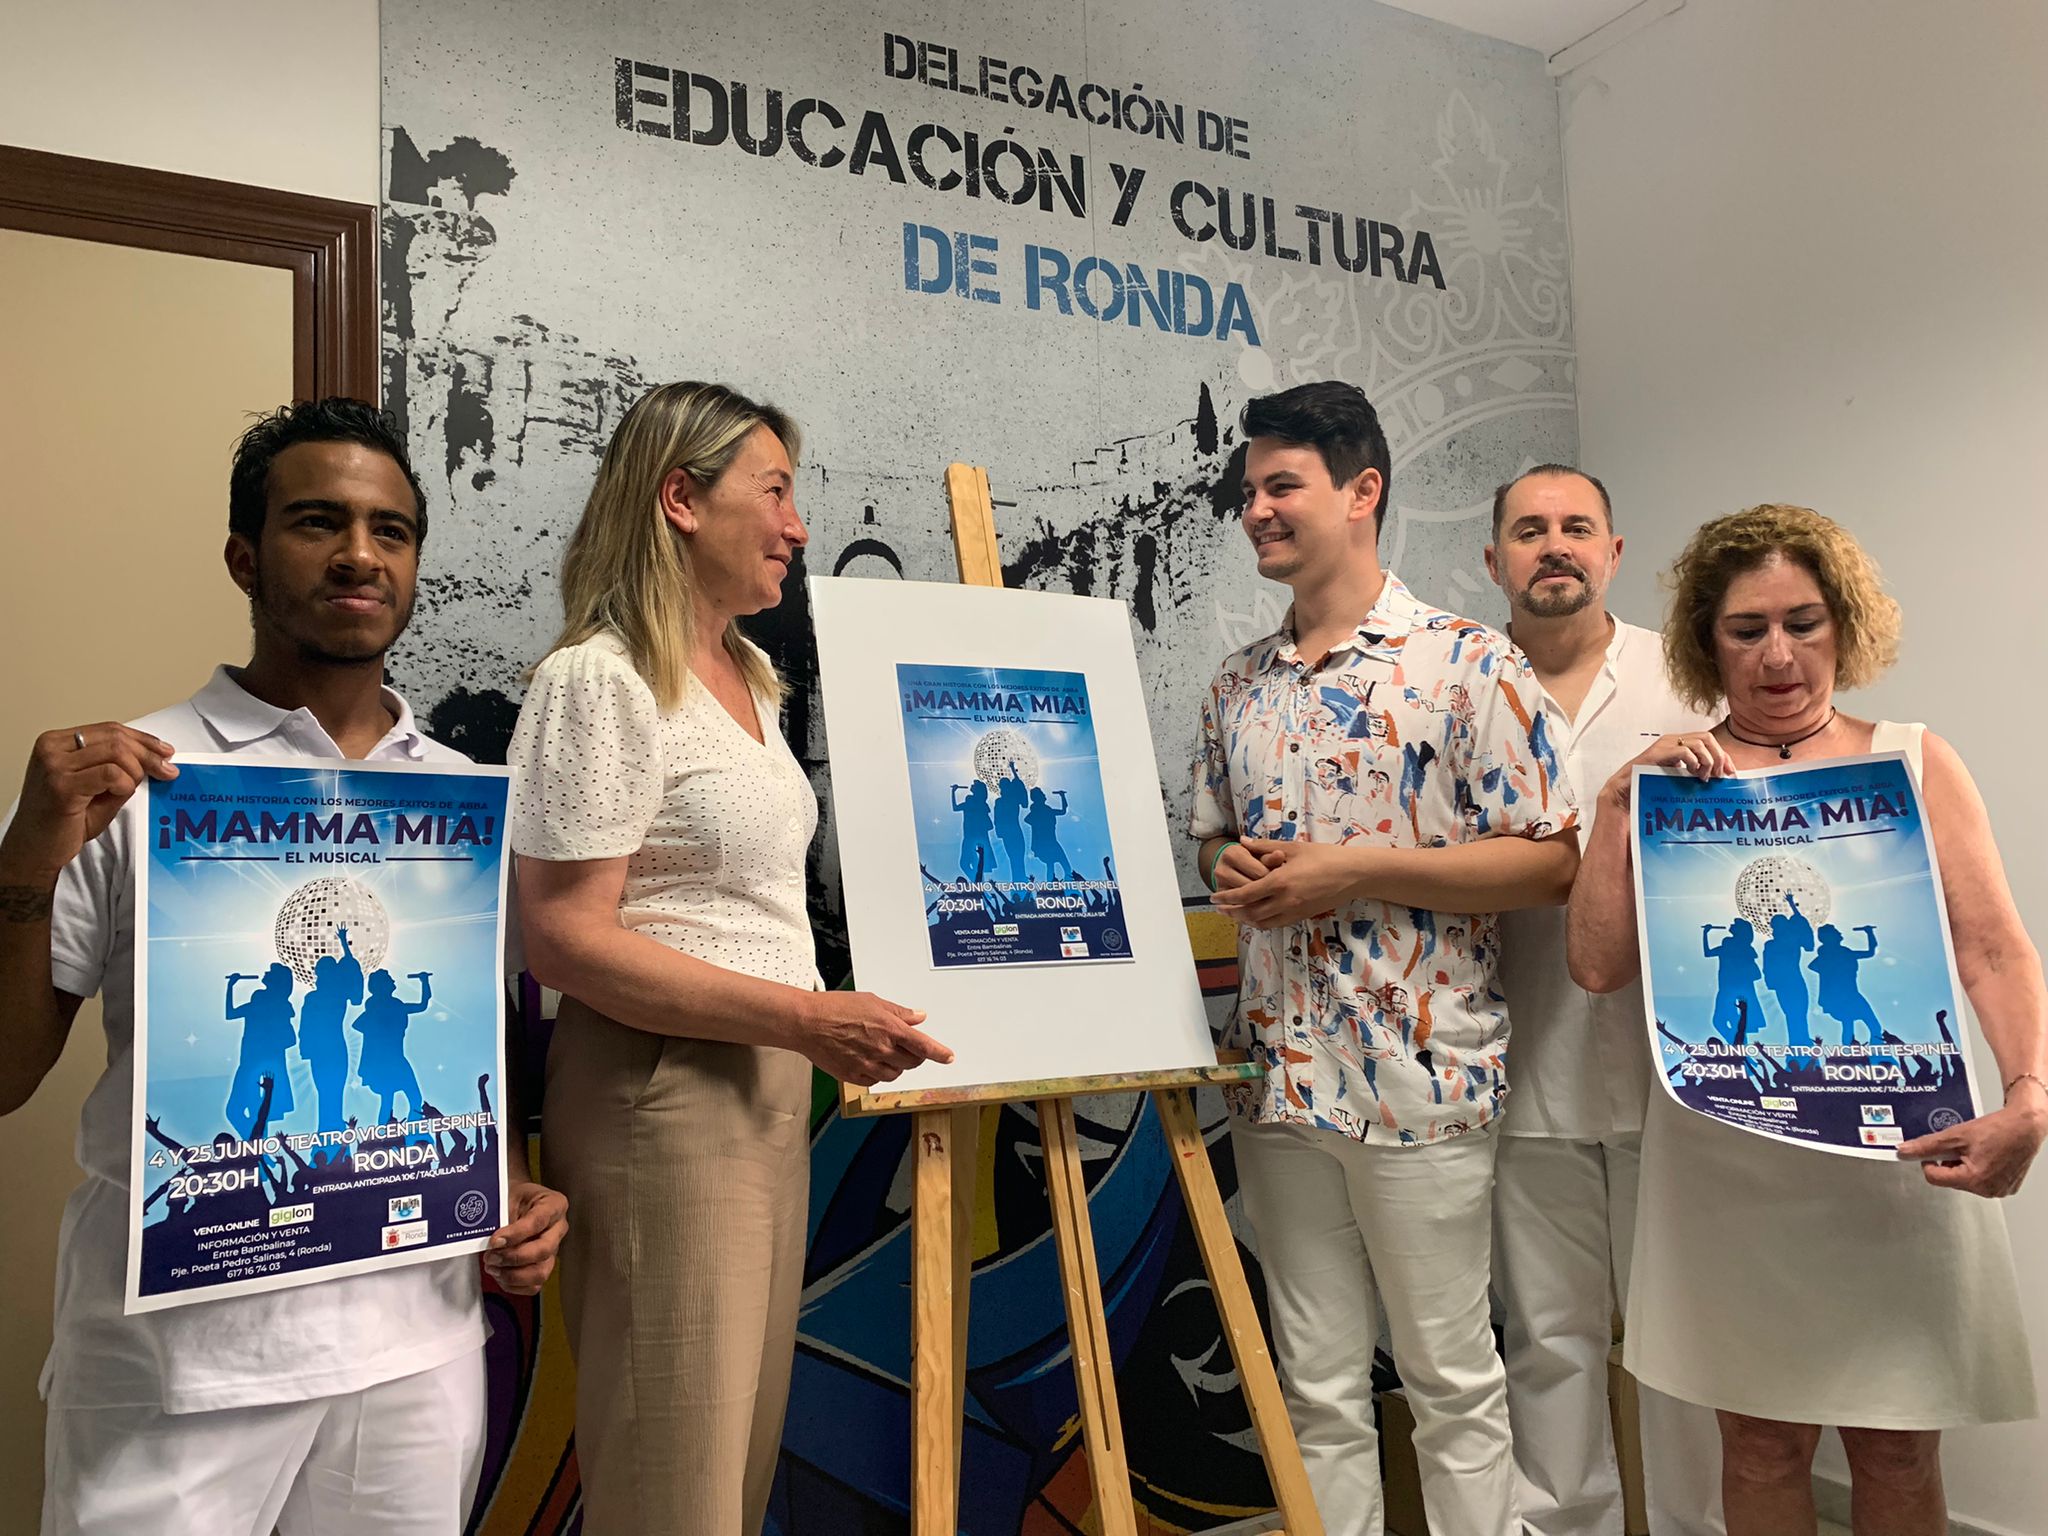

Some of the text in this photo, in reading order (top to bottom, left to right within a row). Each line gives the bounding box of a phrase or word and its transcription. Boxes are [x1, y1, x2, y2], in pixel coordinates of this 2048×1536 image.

[883, 31, 1251, 159] DELEGACIÓN DE
[614, 56, 1446, 290] EDUCACIÓN Y CULTURA
[903, 222, 1261, 346] DE RONDA
[904, 690, 1086, 715] ¡MAMMA MIA!
[986, 715, 1027, 723] MUSICAL
[170, 793, 195, 802] UNA
[200, 794, 233, 803] GRAN
[236, 795, 290, 805] HISTORIA
[294, 797, 317, 806] CON
[321, 798, 342, 806] LOS
[345, 798, 395, 808] MEJORES
[439, 801, 452, 809] DE
[458, 802, 488, 810] ABBA
[1756, 797, 1774, 805] LOS
[1775, 792, 1817, 803] MEJORES
[1852, 784, 1864, 792] DE
[1645, 791, 1909, 835] ¡MAMMA MIA!
[159, 809, 495, 849] ¡MAMMA MIA!
[1737, 835, 1813, 847] EL MUSICAL
[285, 852, 381, 865] EL MUSICAL
[925, 881, 1119, 893] 4 Y 25 JUNIO TEATRO VICENTE ESPINEL
[937, 899, 985, 912] 20:30H
[1035, 897, 1087, 909] RONDA
[1664, 1043, 1961, 1058] 4 Y 25 JUNIO TEATRO VICENTE ESPINEL
[1681, 1062, 1748, 1080] 20:30H
[1824, 1065, 1906, 1081] RONDA
[1888, 1086, 1924, 1094] TAQUILLA
[1762, 1098, 1795, 1109] giglon
[149, 1112, 497, 1168] 4 Y 25 JUNIO TEATRO VICENTE ESPINEL
[354, 1144, 440, 1173] RONDA
[169, 1167, 259, 1199] 20:30H
[313, 1180, 355, 1195] ENTRADA
[353, 1173, 401, 1189] ANTICIPADA
[420, 1166, 456, 1180] TAQUILLA
[271, 1205, 312, 1224] giglon
[194, 1219, 260, 1236] VENTA ONLINE
[198, 1226, 310, 1251] INFORMACIÓN Y VENTA
[213, 1238, 296, 1260] Entre Bambalinas
[171, 1242, 332, 1279] Pje. Poeta Pedro Salinas, 4 (Ronda)
[227, 1262, 281, 1279] 617 16 74 03
